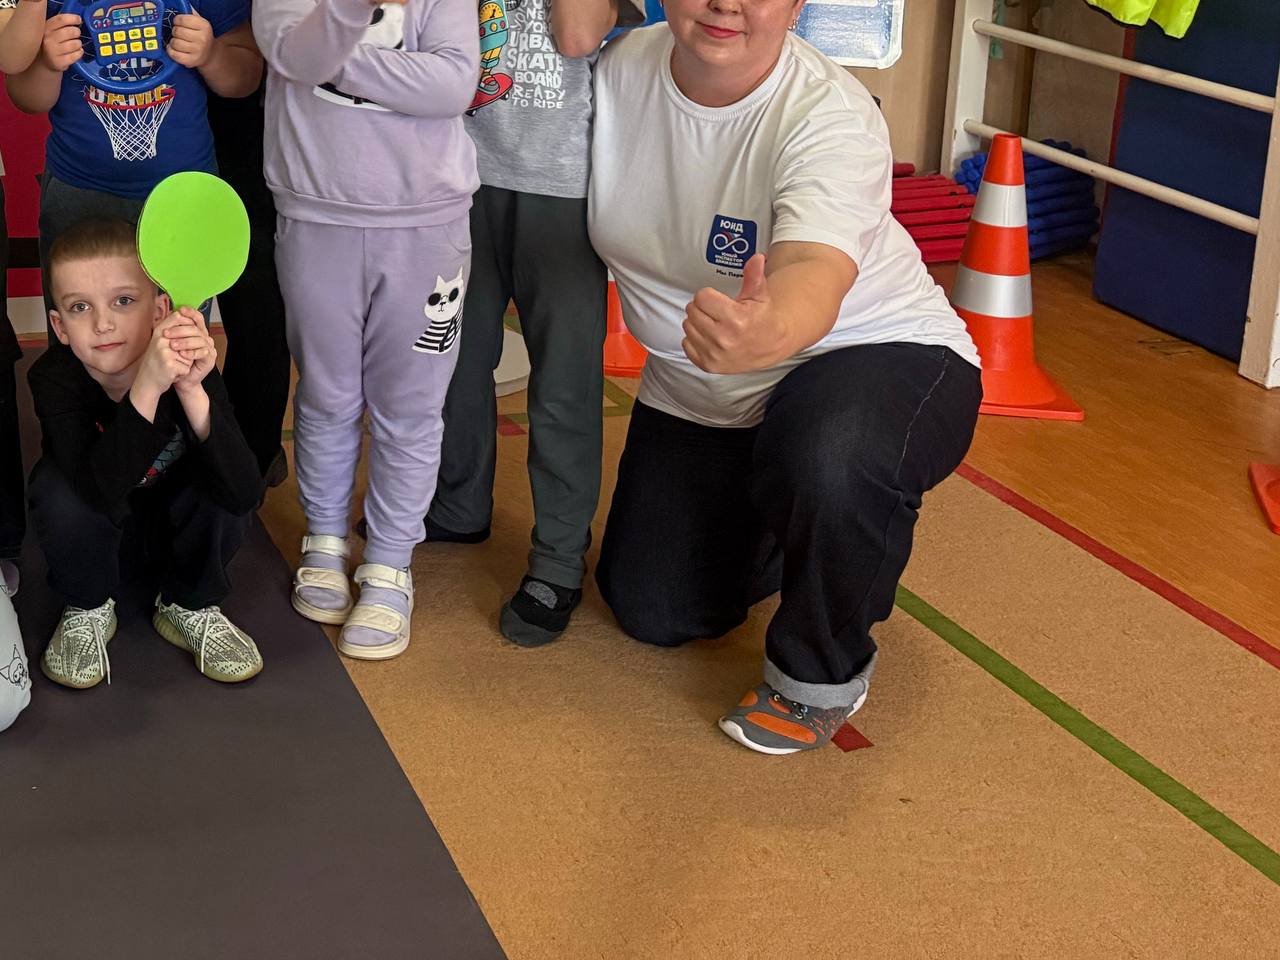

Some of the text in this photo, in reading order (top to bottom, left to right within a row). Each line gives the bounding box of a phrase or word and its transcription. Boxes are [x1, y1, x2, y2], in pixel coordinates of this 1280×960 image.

[508, 31, 555, 52] URBA
[506, 48, 564, 72] SKATE
[514, 69, 563, 89] BOARD
[512, 83, 566, 101] READY
[512, 98, 564, 109] TO RIDE
[720, 220, 744, 233] ЮИД
